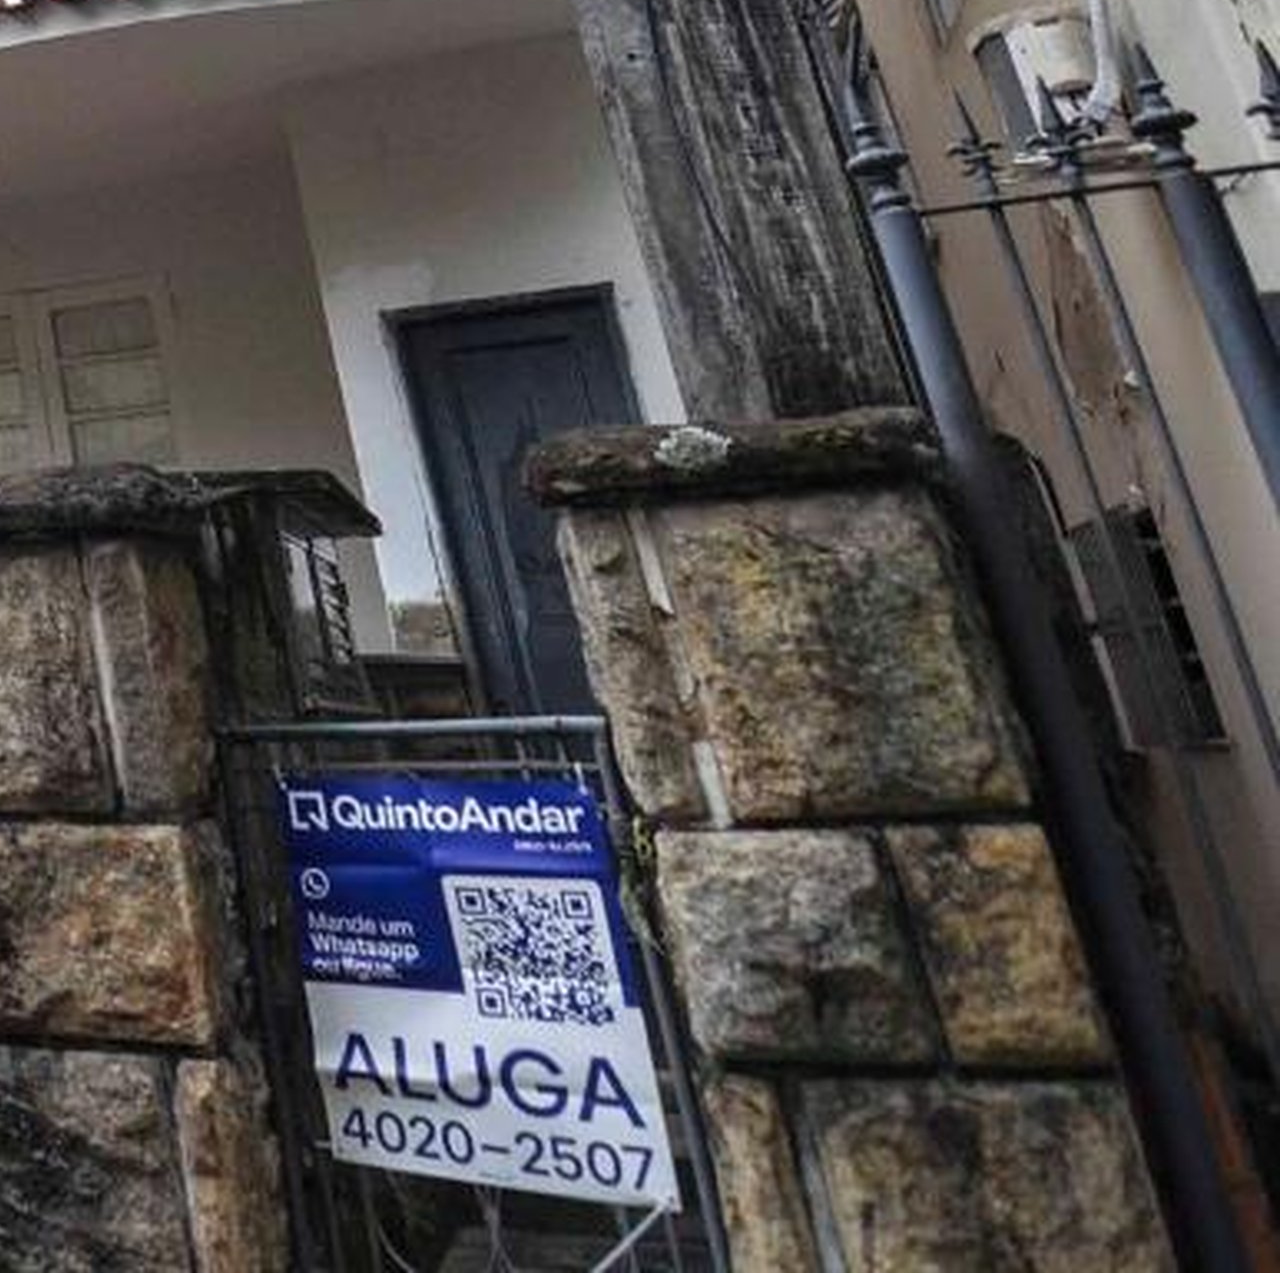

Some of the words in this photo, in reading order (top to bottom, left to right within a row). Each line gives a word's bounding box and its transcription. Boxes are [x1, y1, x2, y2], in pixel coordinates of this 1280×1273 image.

[332, 795, 584, 833] QuintoAndar
[308, 911, 378, 935] Mande
[381, 919, 415, 937] um
[335, 1033, 645, 1128] ALUGA
[342, 1107, 654, 1191] 4020-2507
